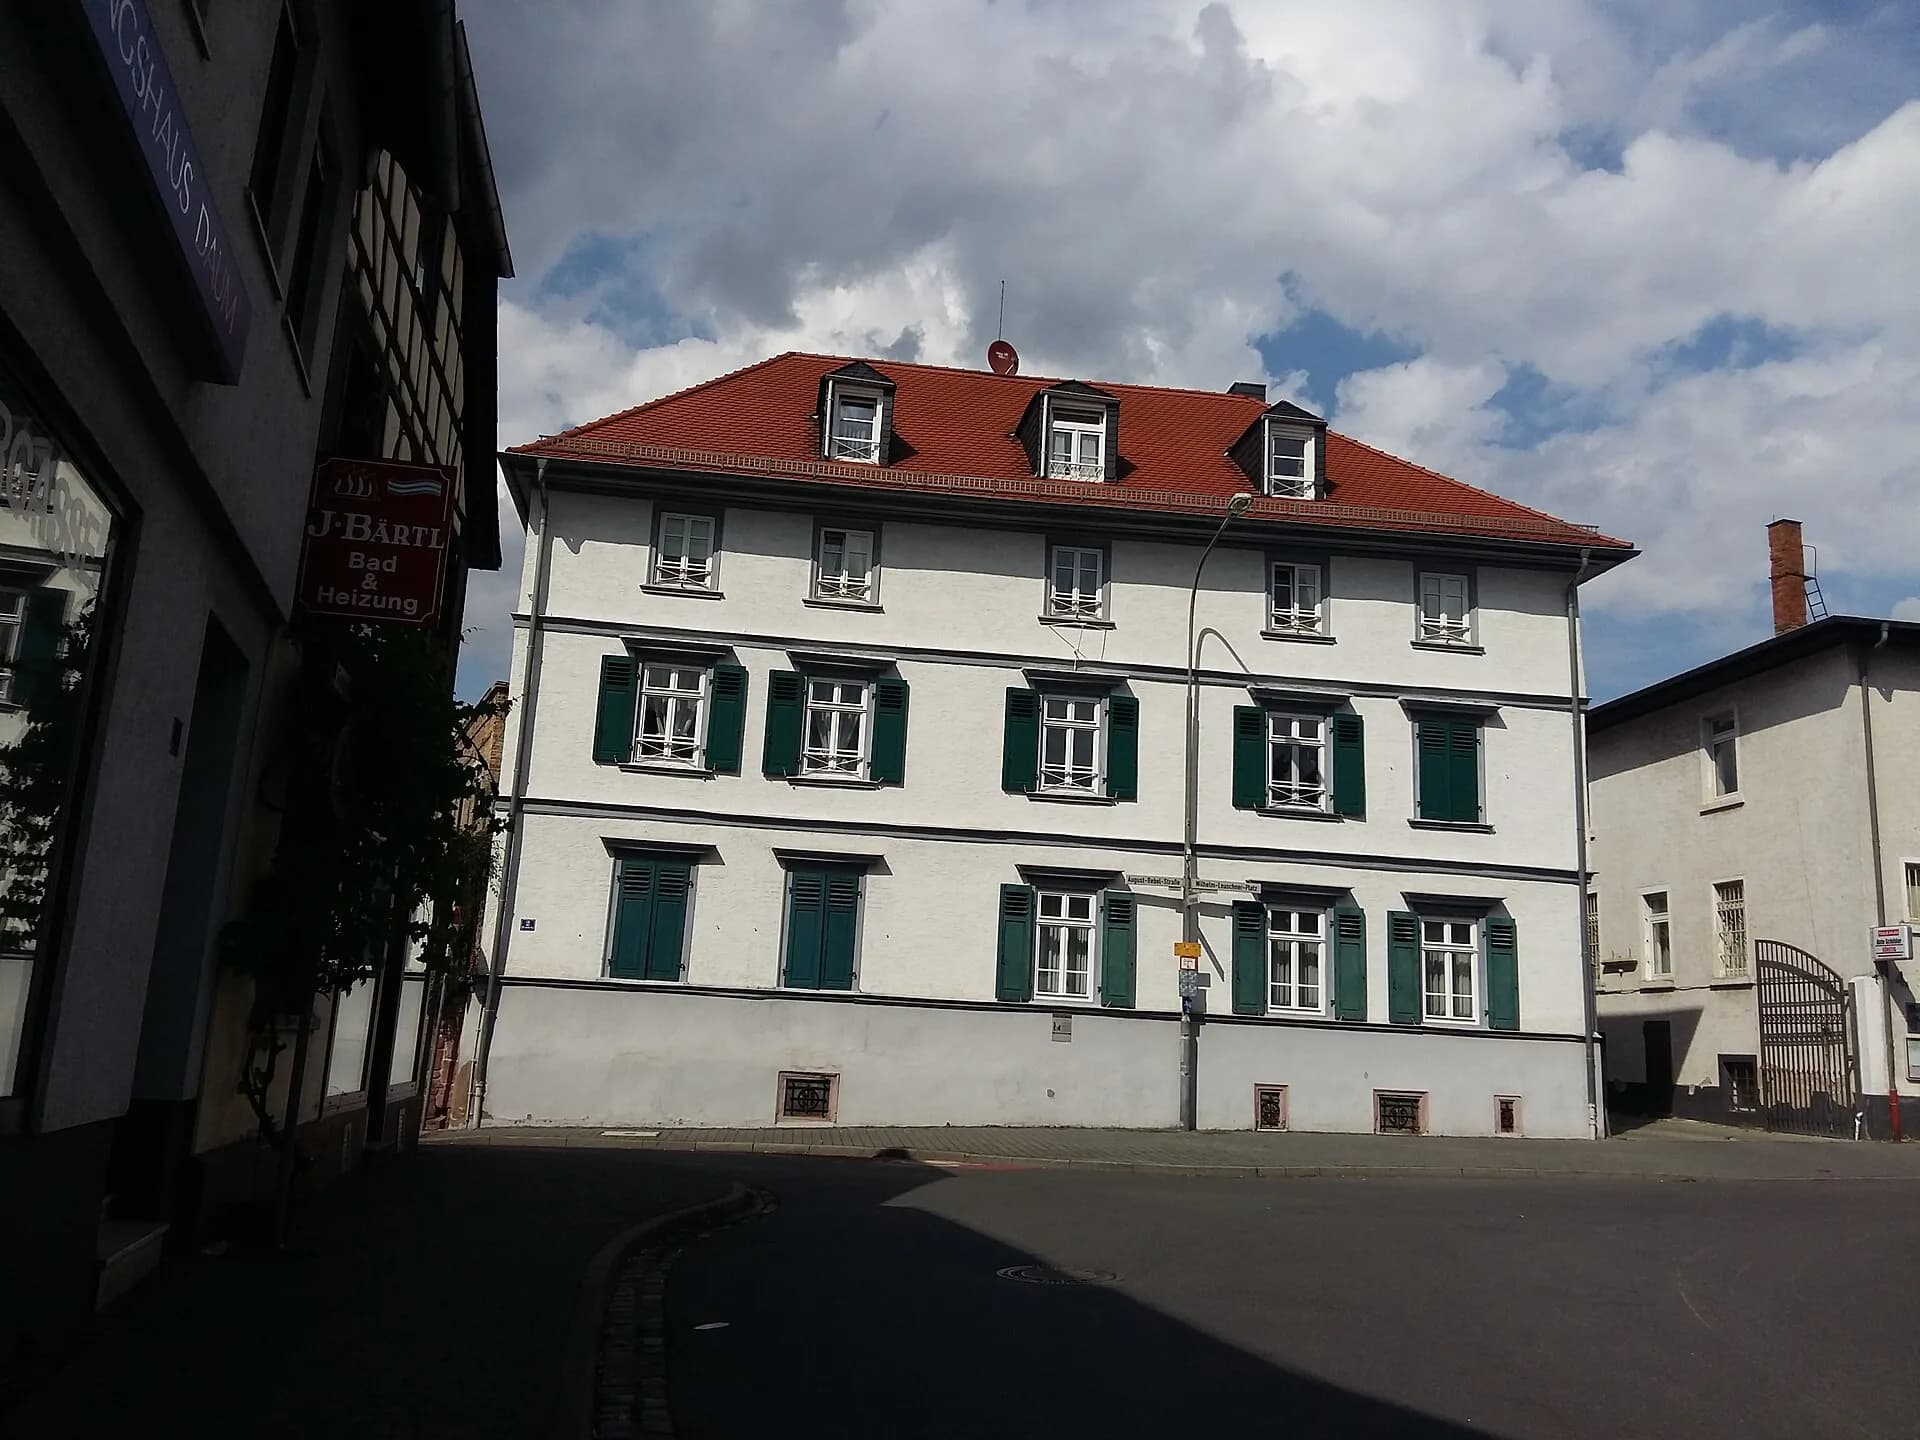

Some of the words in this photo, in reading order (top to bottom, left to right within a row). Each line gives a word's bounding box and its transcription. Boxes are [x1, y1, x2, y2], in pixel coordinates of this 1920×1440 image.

[195, 202, 238, 335] DAUM
[348, 551, 399, 573] Bad
[361, 573, 378, 590] &
[317, 585, 419, 615] Heizung
